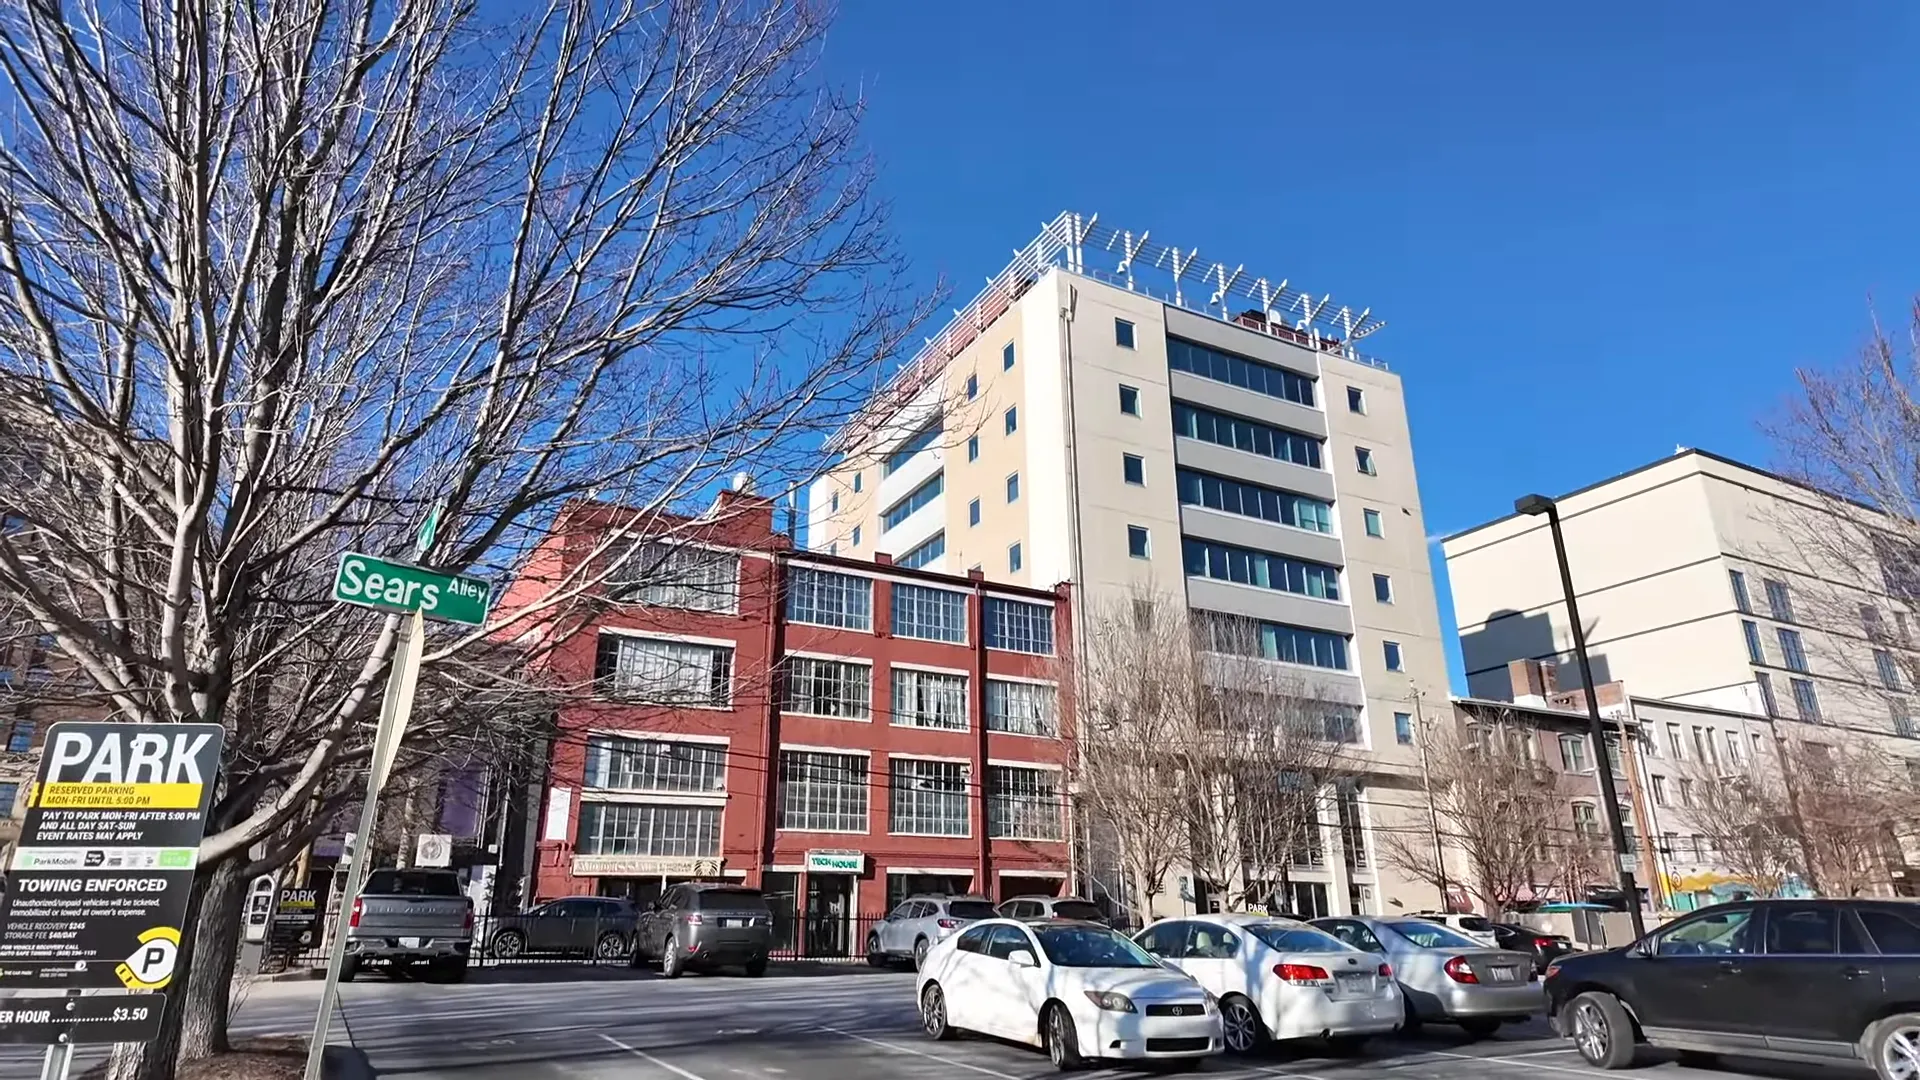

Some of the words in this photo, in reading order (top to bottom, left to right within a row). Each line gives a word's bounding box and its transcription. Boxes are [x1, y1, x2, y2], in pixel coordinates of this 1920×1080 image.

[340, 559, 439, 610] Sears
[447, 577, 487, 604] Alley
[46, 732, 213, 784] PARK
[49, 786, 94, 795] RESERVED
[96, 786, 135, 795] PARKING
[46, 796, 86, 805] MON-FRI
[88, 796, 114, 805] UNTIL
[116, 796, 133, 805] 5:00
[136, 796, 151, 805] PM
[42, 811, 61, 820] PAY
[62, 811, 75, 820] TO
[76, 811, 100, 820] PARK
[101, 811, 138, 820] MON-FRI
[139, 811, 166, 820] AFTER
[168, 811, 185, 820] 5:00
[186, 811, 201, 820] PM
[39, 821, 57, 830] AND
[59, 821, 77, 830] ALL
[78, 821, 96, 830] DAY
[98, 821, 136, 830] SAT-SUN
[36, 831, 65, 841] EVENT
[67, 831, 94, 841] RATES
[95, 831, 116, 841] MAY
[116, 831, 144, 841] APPLY
[33, 857, 78, 866] ParkMobile
[811, 857, 832, 866] TECH
[832, 859, 858, 869] HOUSE
[18, 878, 82, 892] TOWING
[85, 878, 167, 892] ENFORCED
[281, 890, 317, 902] PARK
[12, 899, 82, 908] Unauthorized/unpaid
[82, 899, 109, 907] vehicles
[133, 899, 160, 907] ticketed,
[1248, 903, 1268, 913] PARK
[10, 908, 51, 916] immobilized
[60, 908, 81, 916] towed
[90, 908, 116, 916] owner's
[117, 909, 146, 917] expense.
[141, 947, 165, 973] P
[15, 1010, 50, 1023] HOUR
